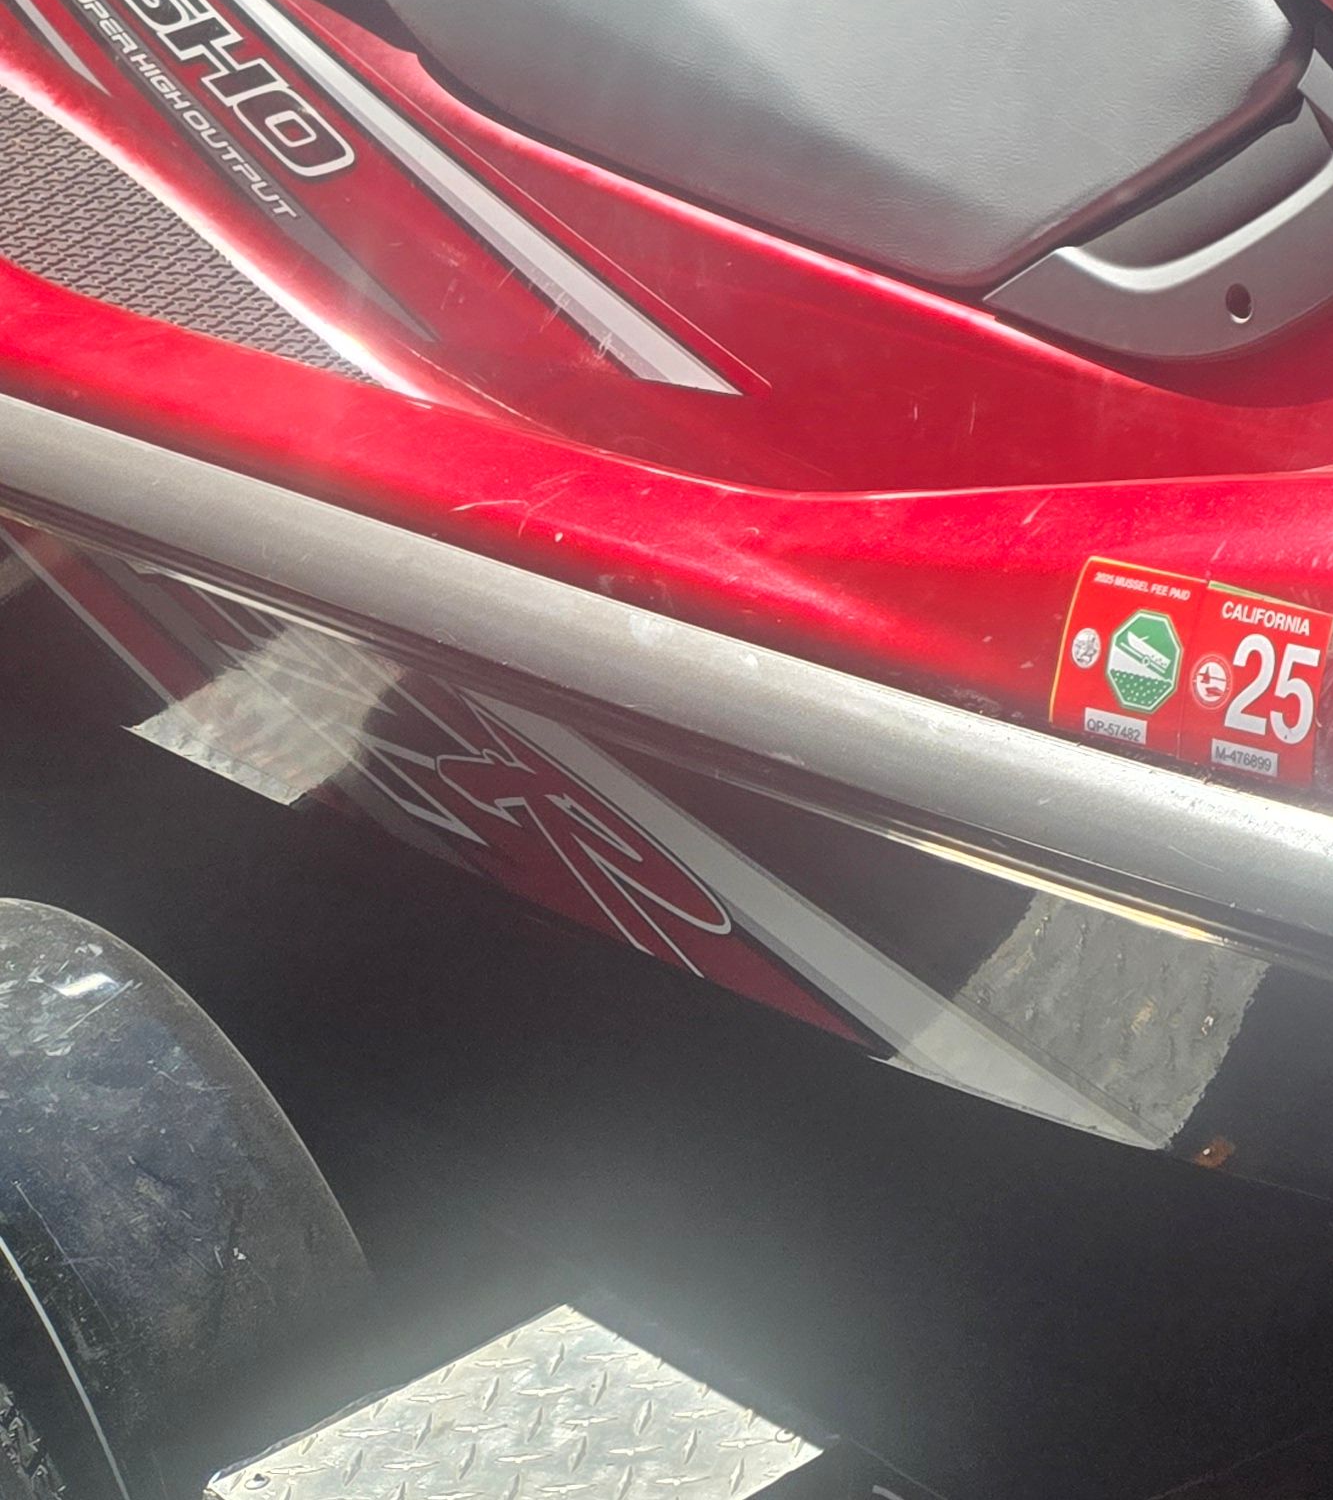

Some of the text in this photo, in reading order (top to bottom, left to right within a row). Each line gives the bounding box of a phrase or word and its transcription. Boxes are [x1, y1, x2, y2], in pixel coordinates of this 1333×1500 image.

[129, 52, 193, 114] HIGH
[182, 107, 298, 221] OUTPUT
[1114, 575, 1149, 593] MUSSEL
[1150, 583, 1169, 596] FEE
[1169, 587, 1191, 601] PAID
[1222, 601, 1310, 636] CALIFORNIA
[1224, 634, 1320, 744] 25
[1215, 746, 1272, 772] M-476899
